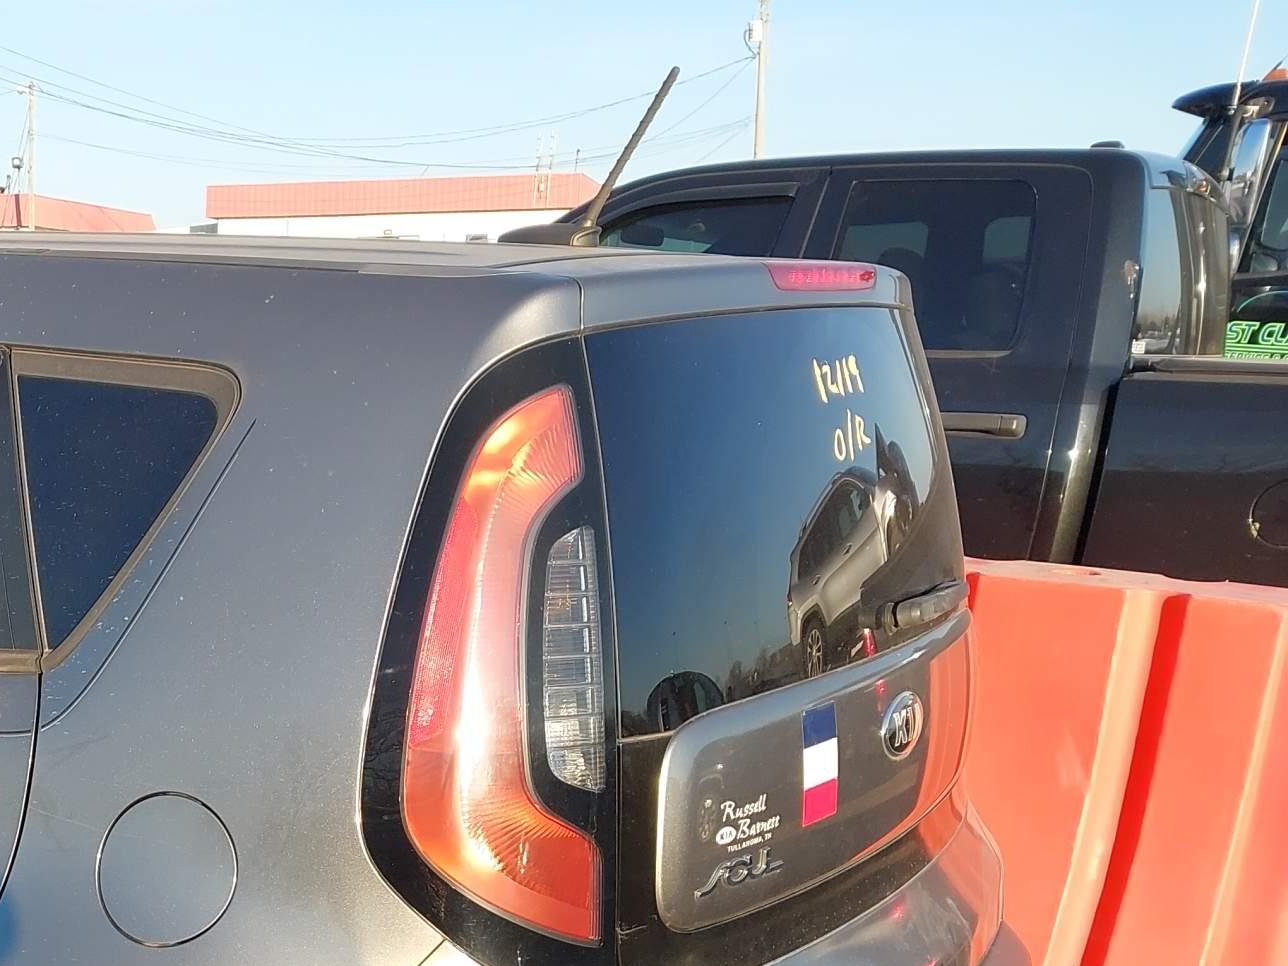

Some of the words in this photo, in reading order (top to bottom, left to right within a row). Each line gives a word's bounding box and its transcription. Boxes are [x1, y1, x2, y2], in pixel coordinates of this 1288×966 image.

[1259, 322, 1288, 346] CL
[813, 354, 865, 404] 12/19
[720, 793, 767, 823] Russell
